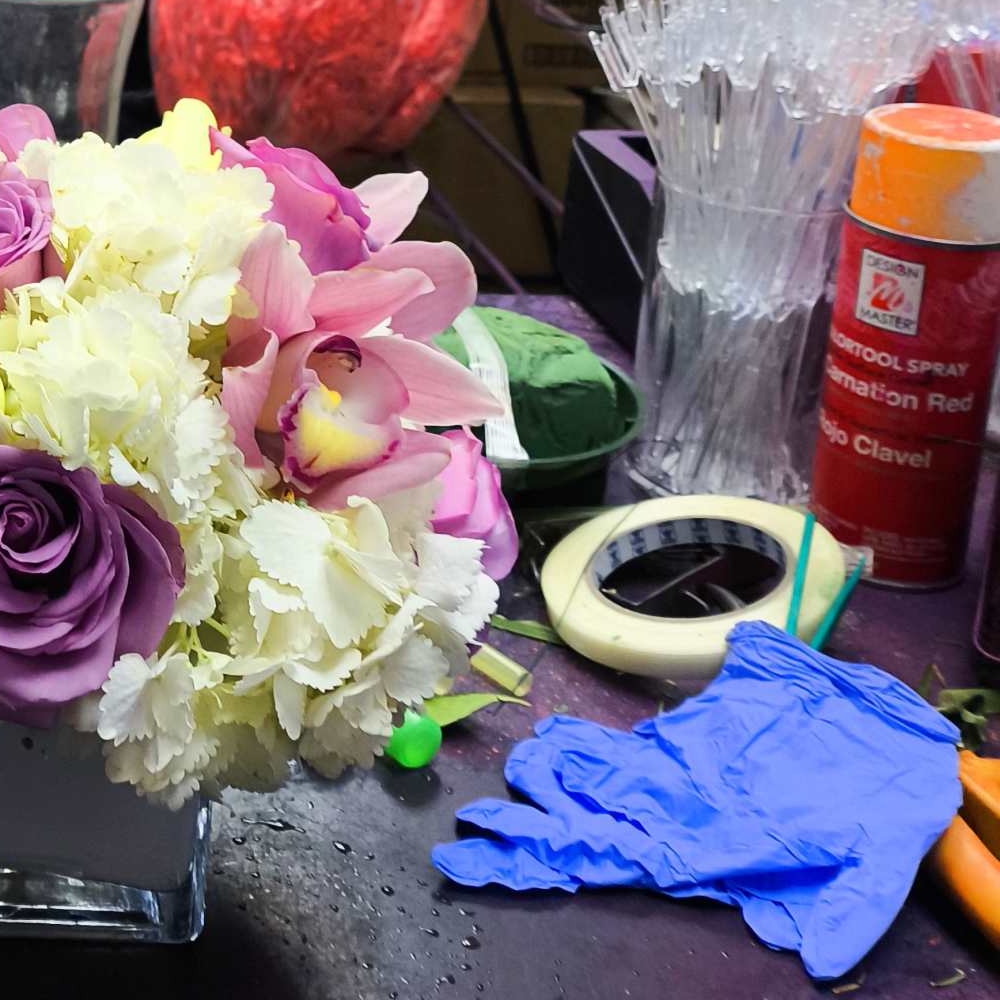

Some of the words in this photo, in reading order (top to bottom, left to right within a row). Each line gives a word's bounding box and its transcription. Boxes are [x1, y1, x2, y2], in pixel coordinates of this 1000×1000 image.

[867, 254, 919, 279] DESIGN
[860, 306, 914, 331] MASTER
[907, 358, 970, 378] SPRAY
[928, 392, 975, 413] Red
[853, 433, 933, 469] Clavel
